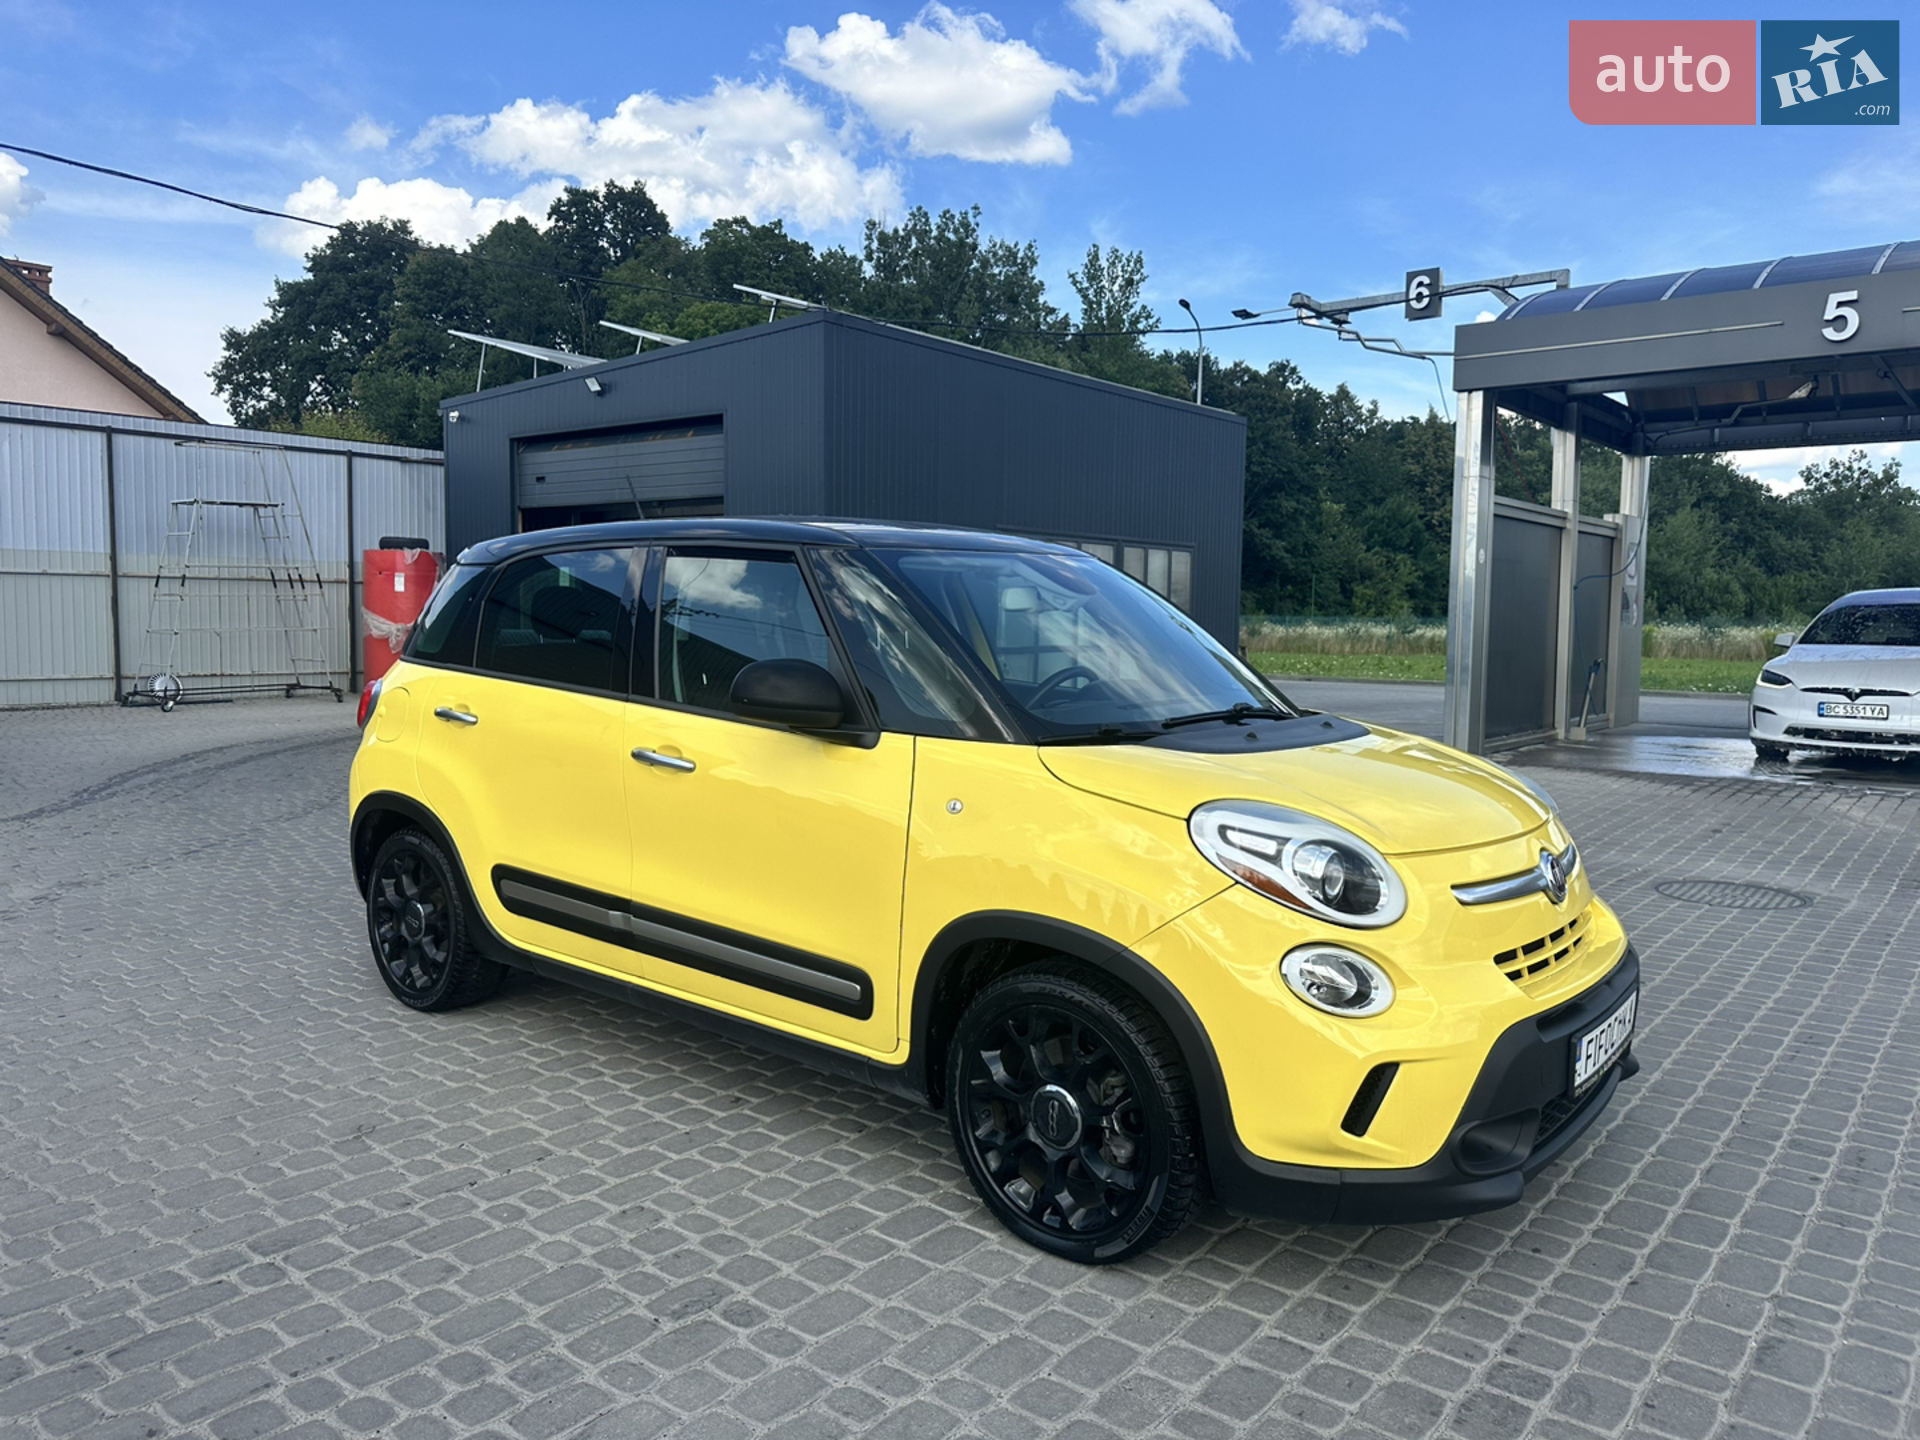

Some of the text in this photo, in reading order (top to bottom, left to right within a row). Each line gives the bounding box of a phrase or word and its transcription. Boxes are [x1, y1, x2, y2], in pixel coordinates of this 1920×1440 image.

[1409, 275, 1431, 310] 6
[1821, 290, 1860, 341] 5
[1825, 705, 1840, 714] BC
[1870, 706, 1885, 716] YA
